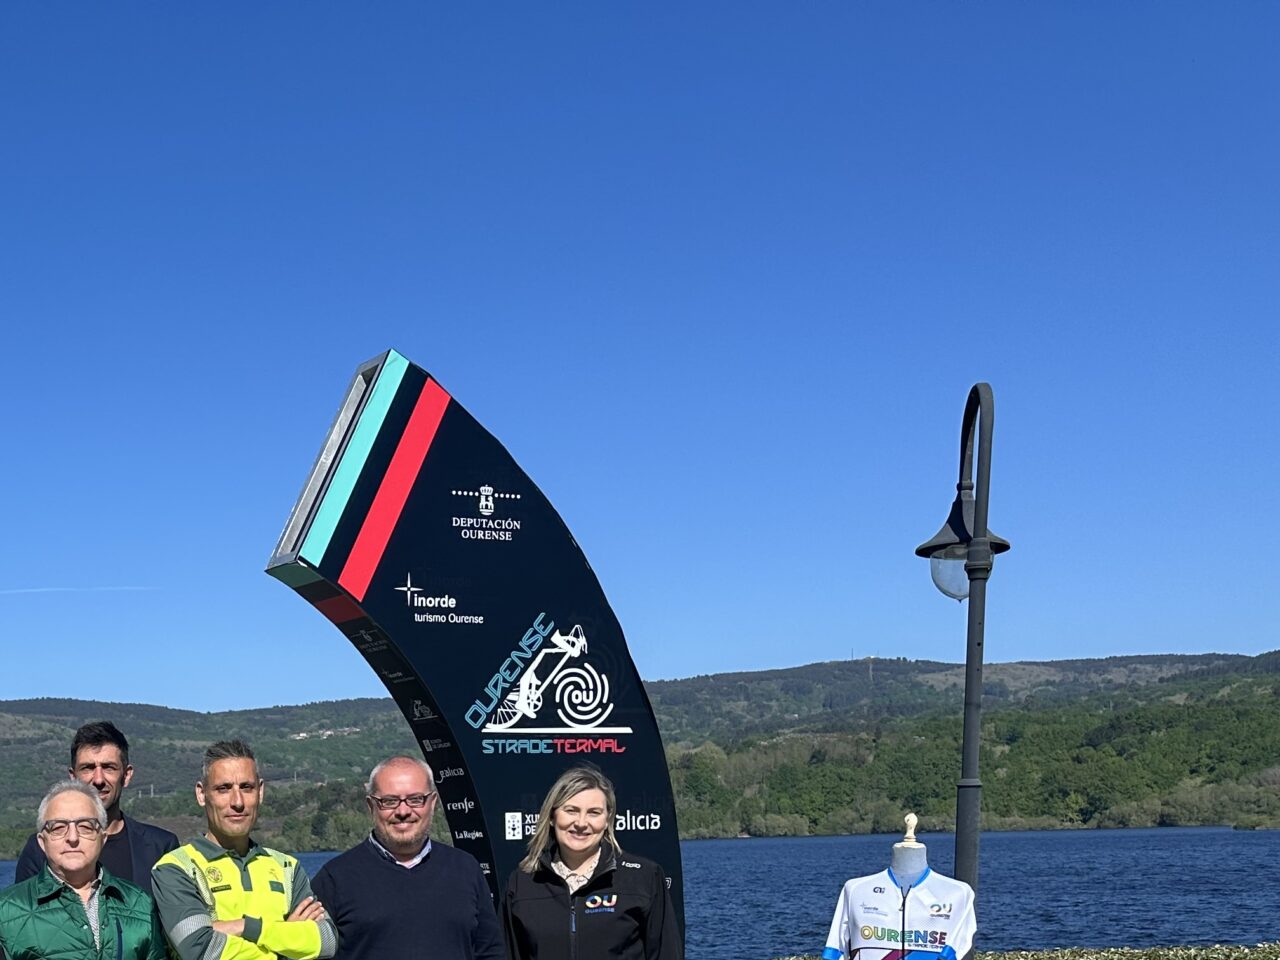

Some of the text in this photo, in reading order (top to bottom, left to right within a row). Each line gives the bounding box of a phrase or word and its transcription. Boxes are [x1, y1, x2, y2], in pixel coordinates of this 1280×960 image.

[452, 516, 521, 530] DEPUTACIÓN
[461, 529, 515, 541] OURENSE
[414, 594, 456, 608] inorde
[415, 613, 483, 623] turismo Ourense
[464, 612, 554, 729] OURENSE
[571, 688, 594, 704] OU
[435, 768, 465, 784] galicia
[447, 798, 474, 813] renfe
[615, 810, 661, 831] alicia
[454, 830, 484, 841] La Región
[586, 895, 618, 908] OU
[860, 925, 947, 945] OURENSE
